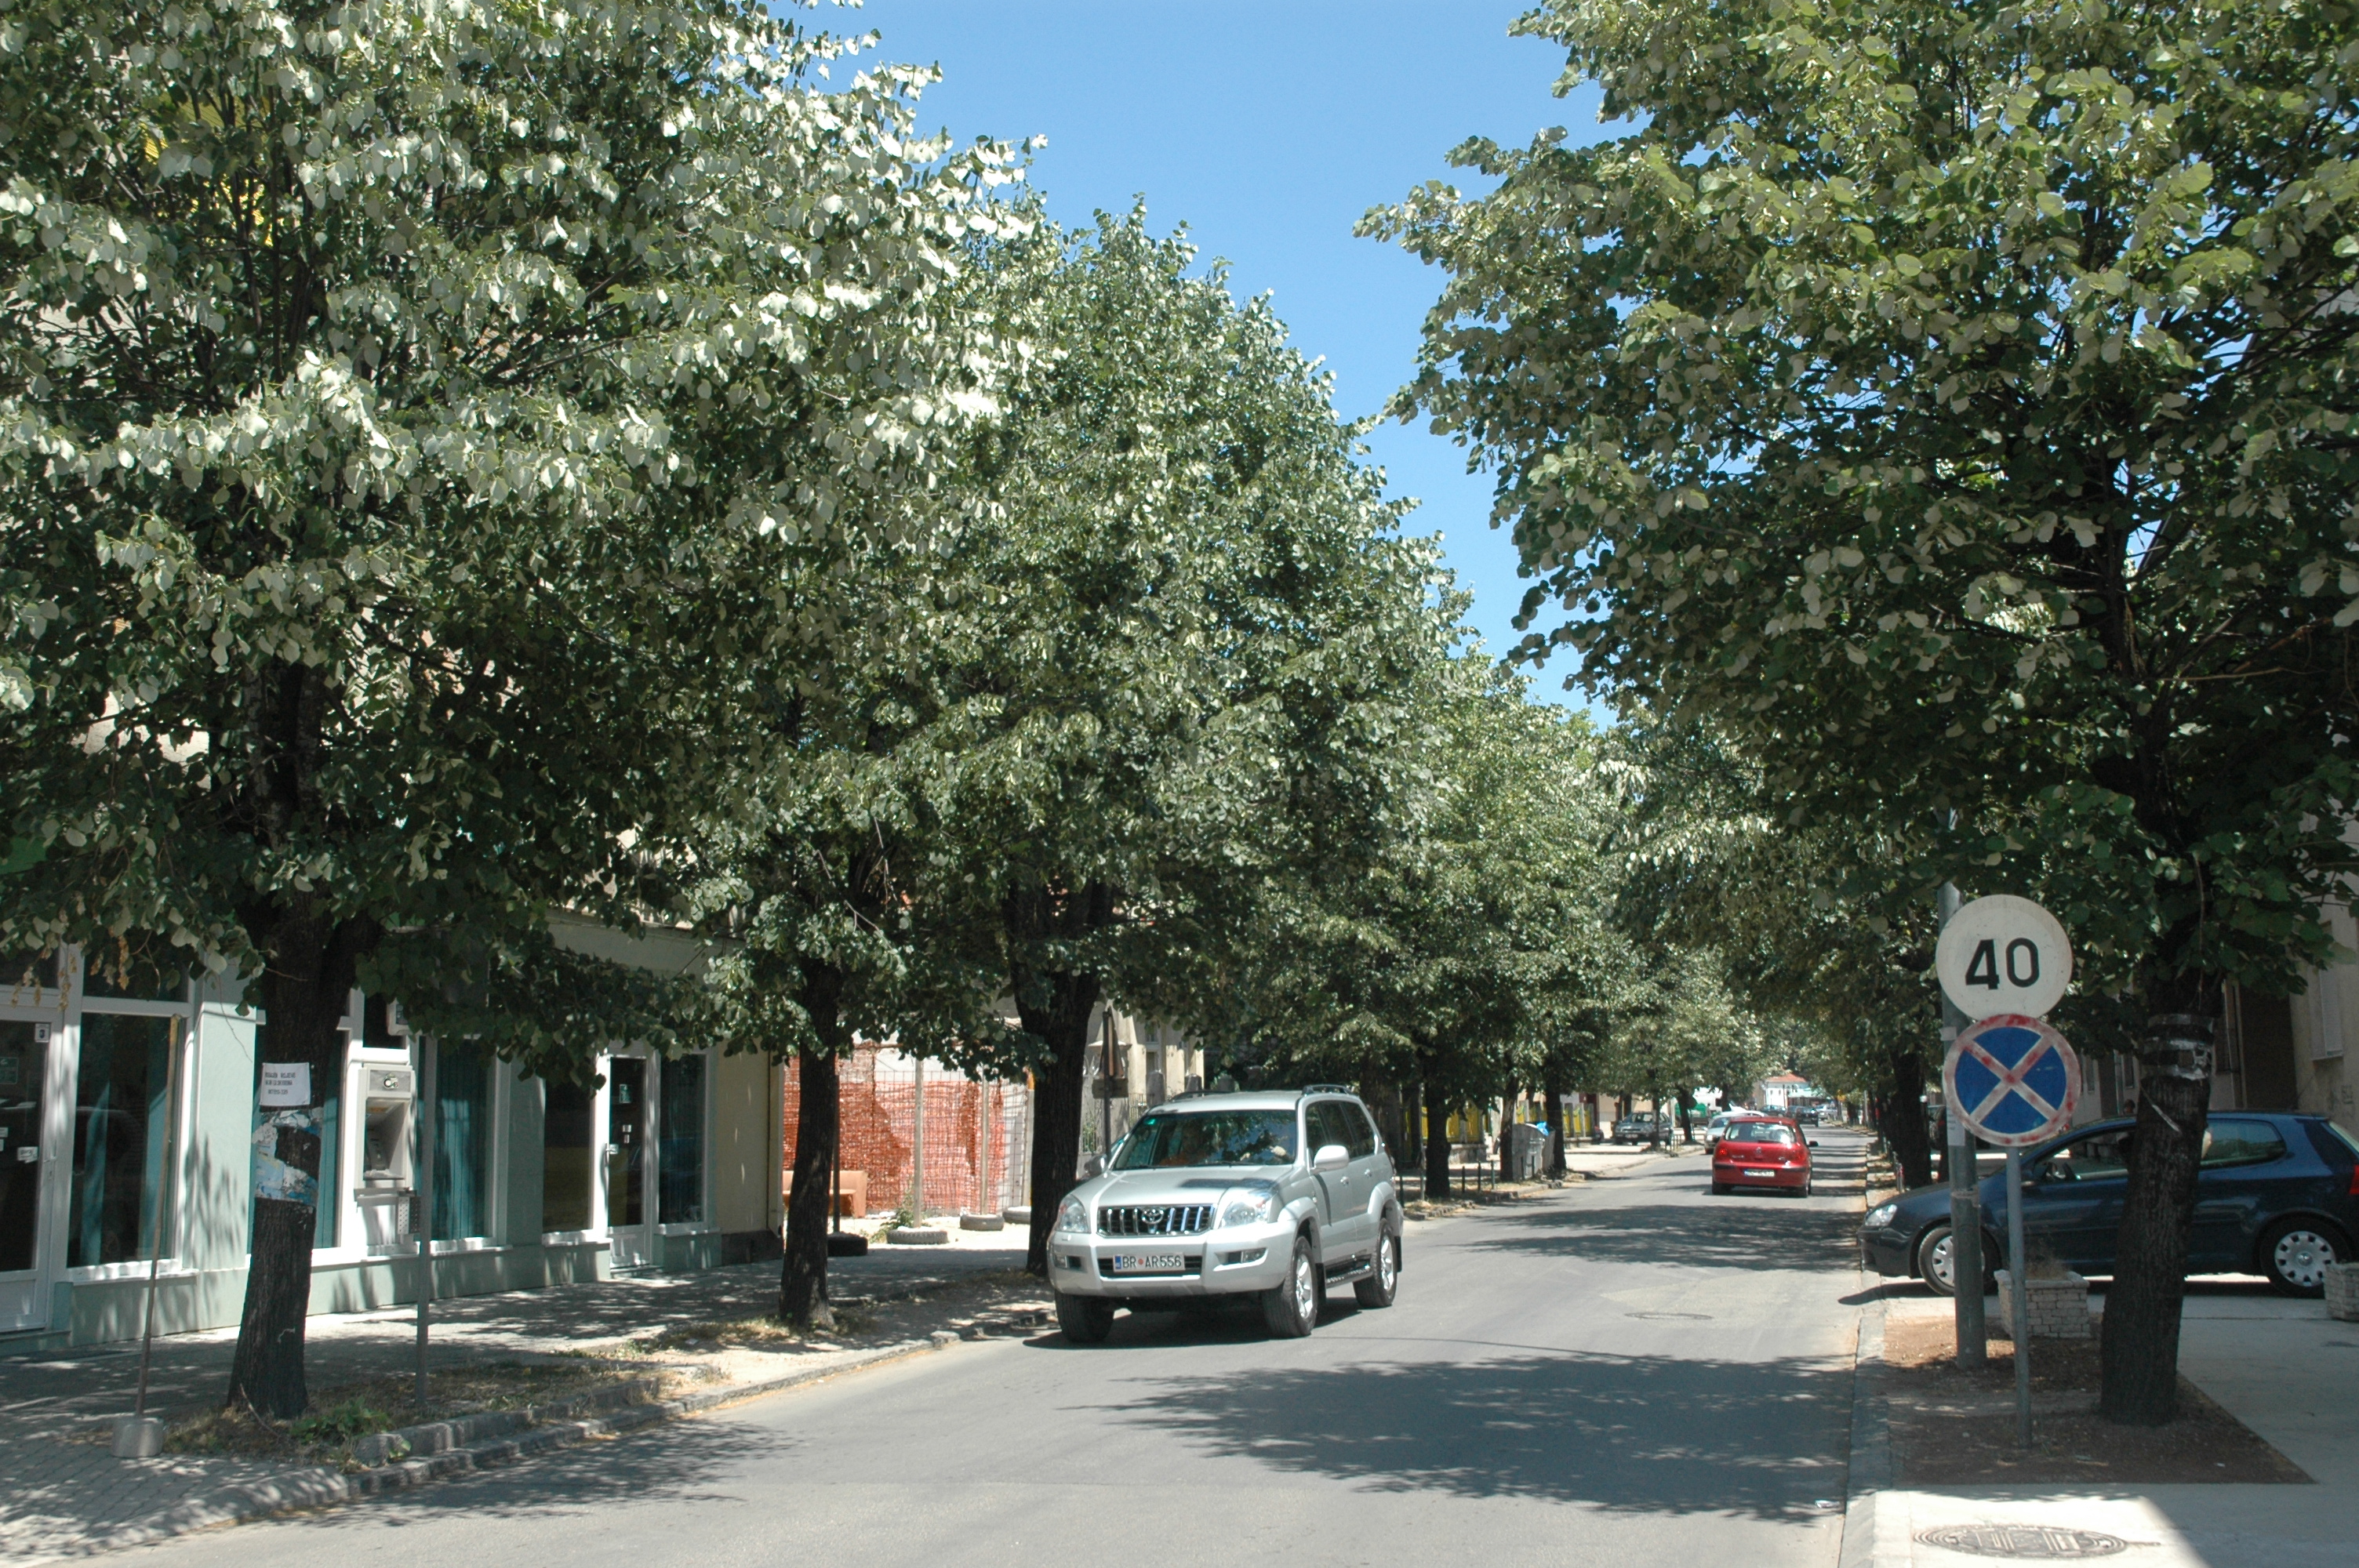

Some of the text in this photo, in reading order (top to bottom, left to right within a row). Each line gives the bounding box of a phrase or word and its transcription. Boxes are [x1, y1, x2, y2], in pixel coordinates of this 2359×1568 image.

[1965, 938, 2040, 990] 40
[1122, 1255, 1182, 1268] BR AR556
